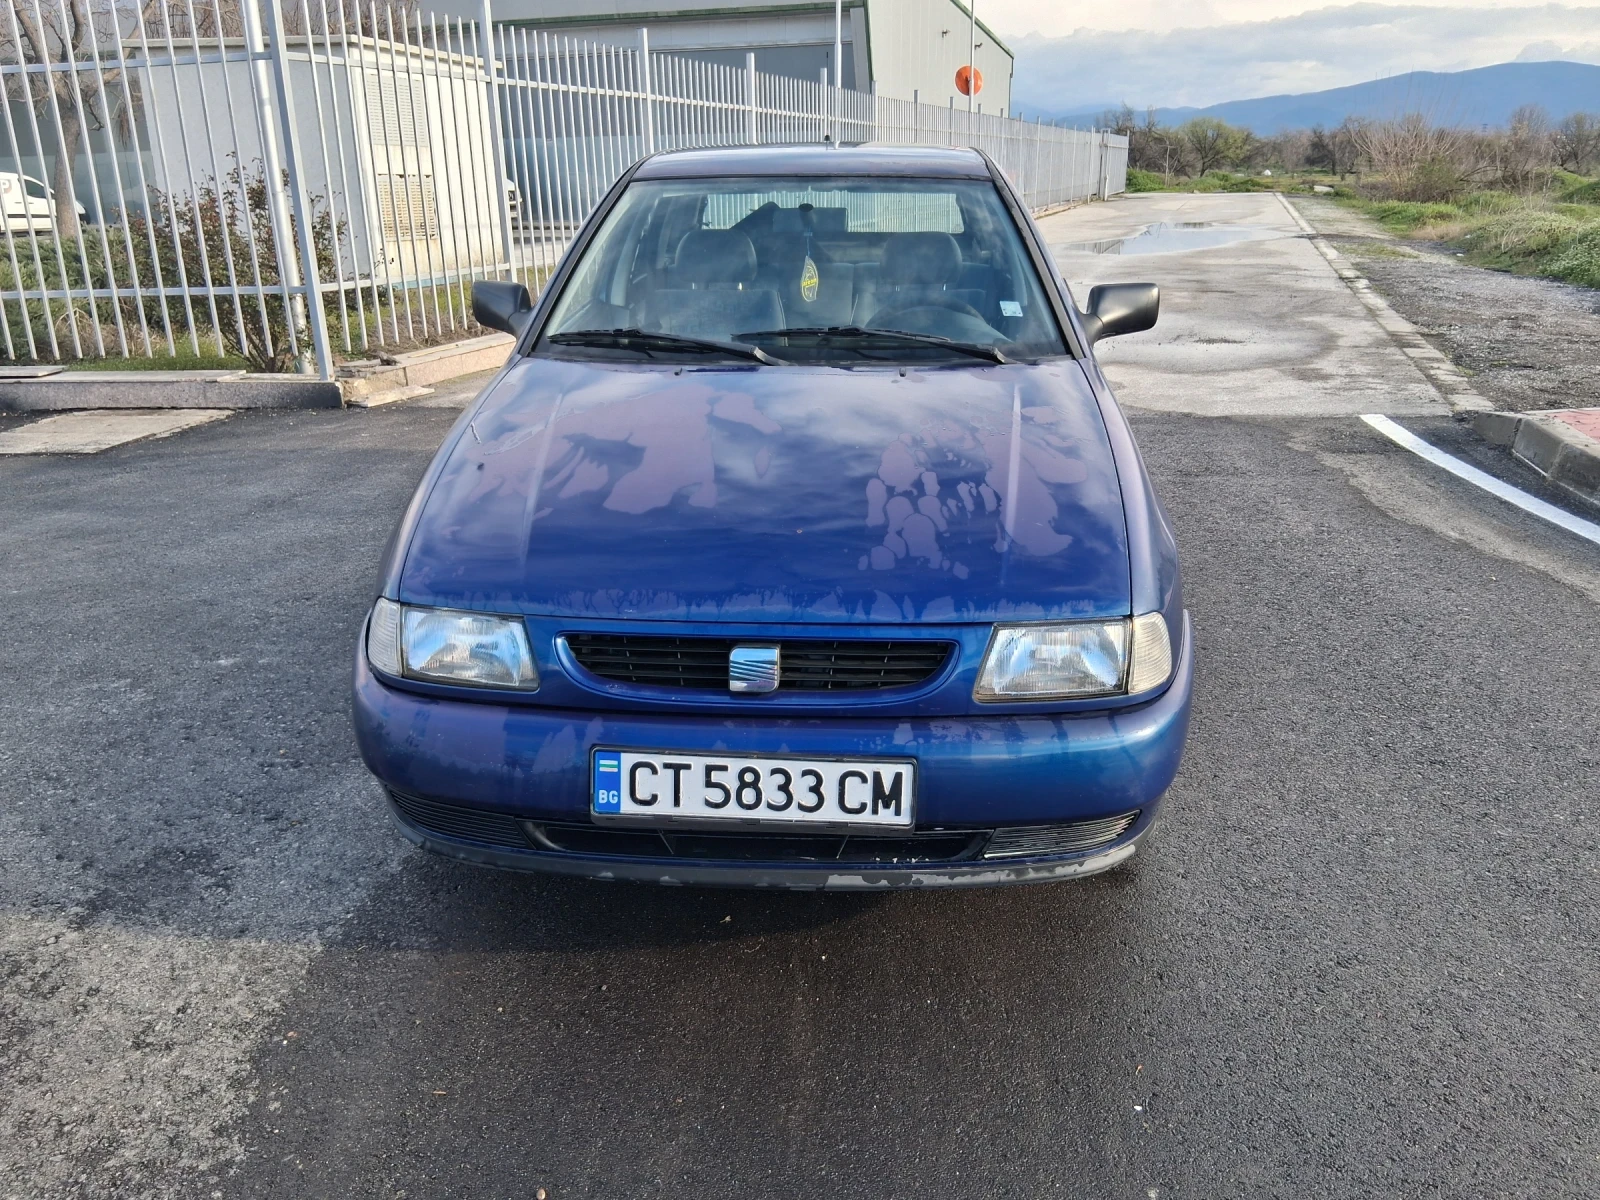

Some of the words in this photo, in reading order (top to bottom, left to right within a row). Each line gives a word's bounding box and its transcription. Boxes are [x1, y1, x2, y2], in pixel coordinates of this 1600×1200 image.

[598, 789, 619, 804] BG
[629, 761, 692, 808] CT
[704, 764, 825, 813] 5833
[838, 770, 903, 817] CM
